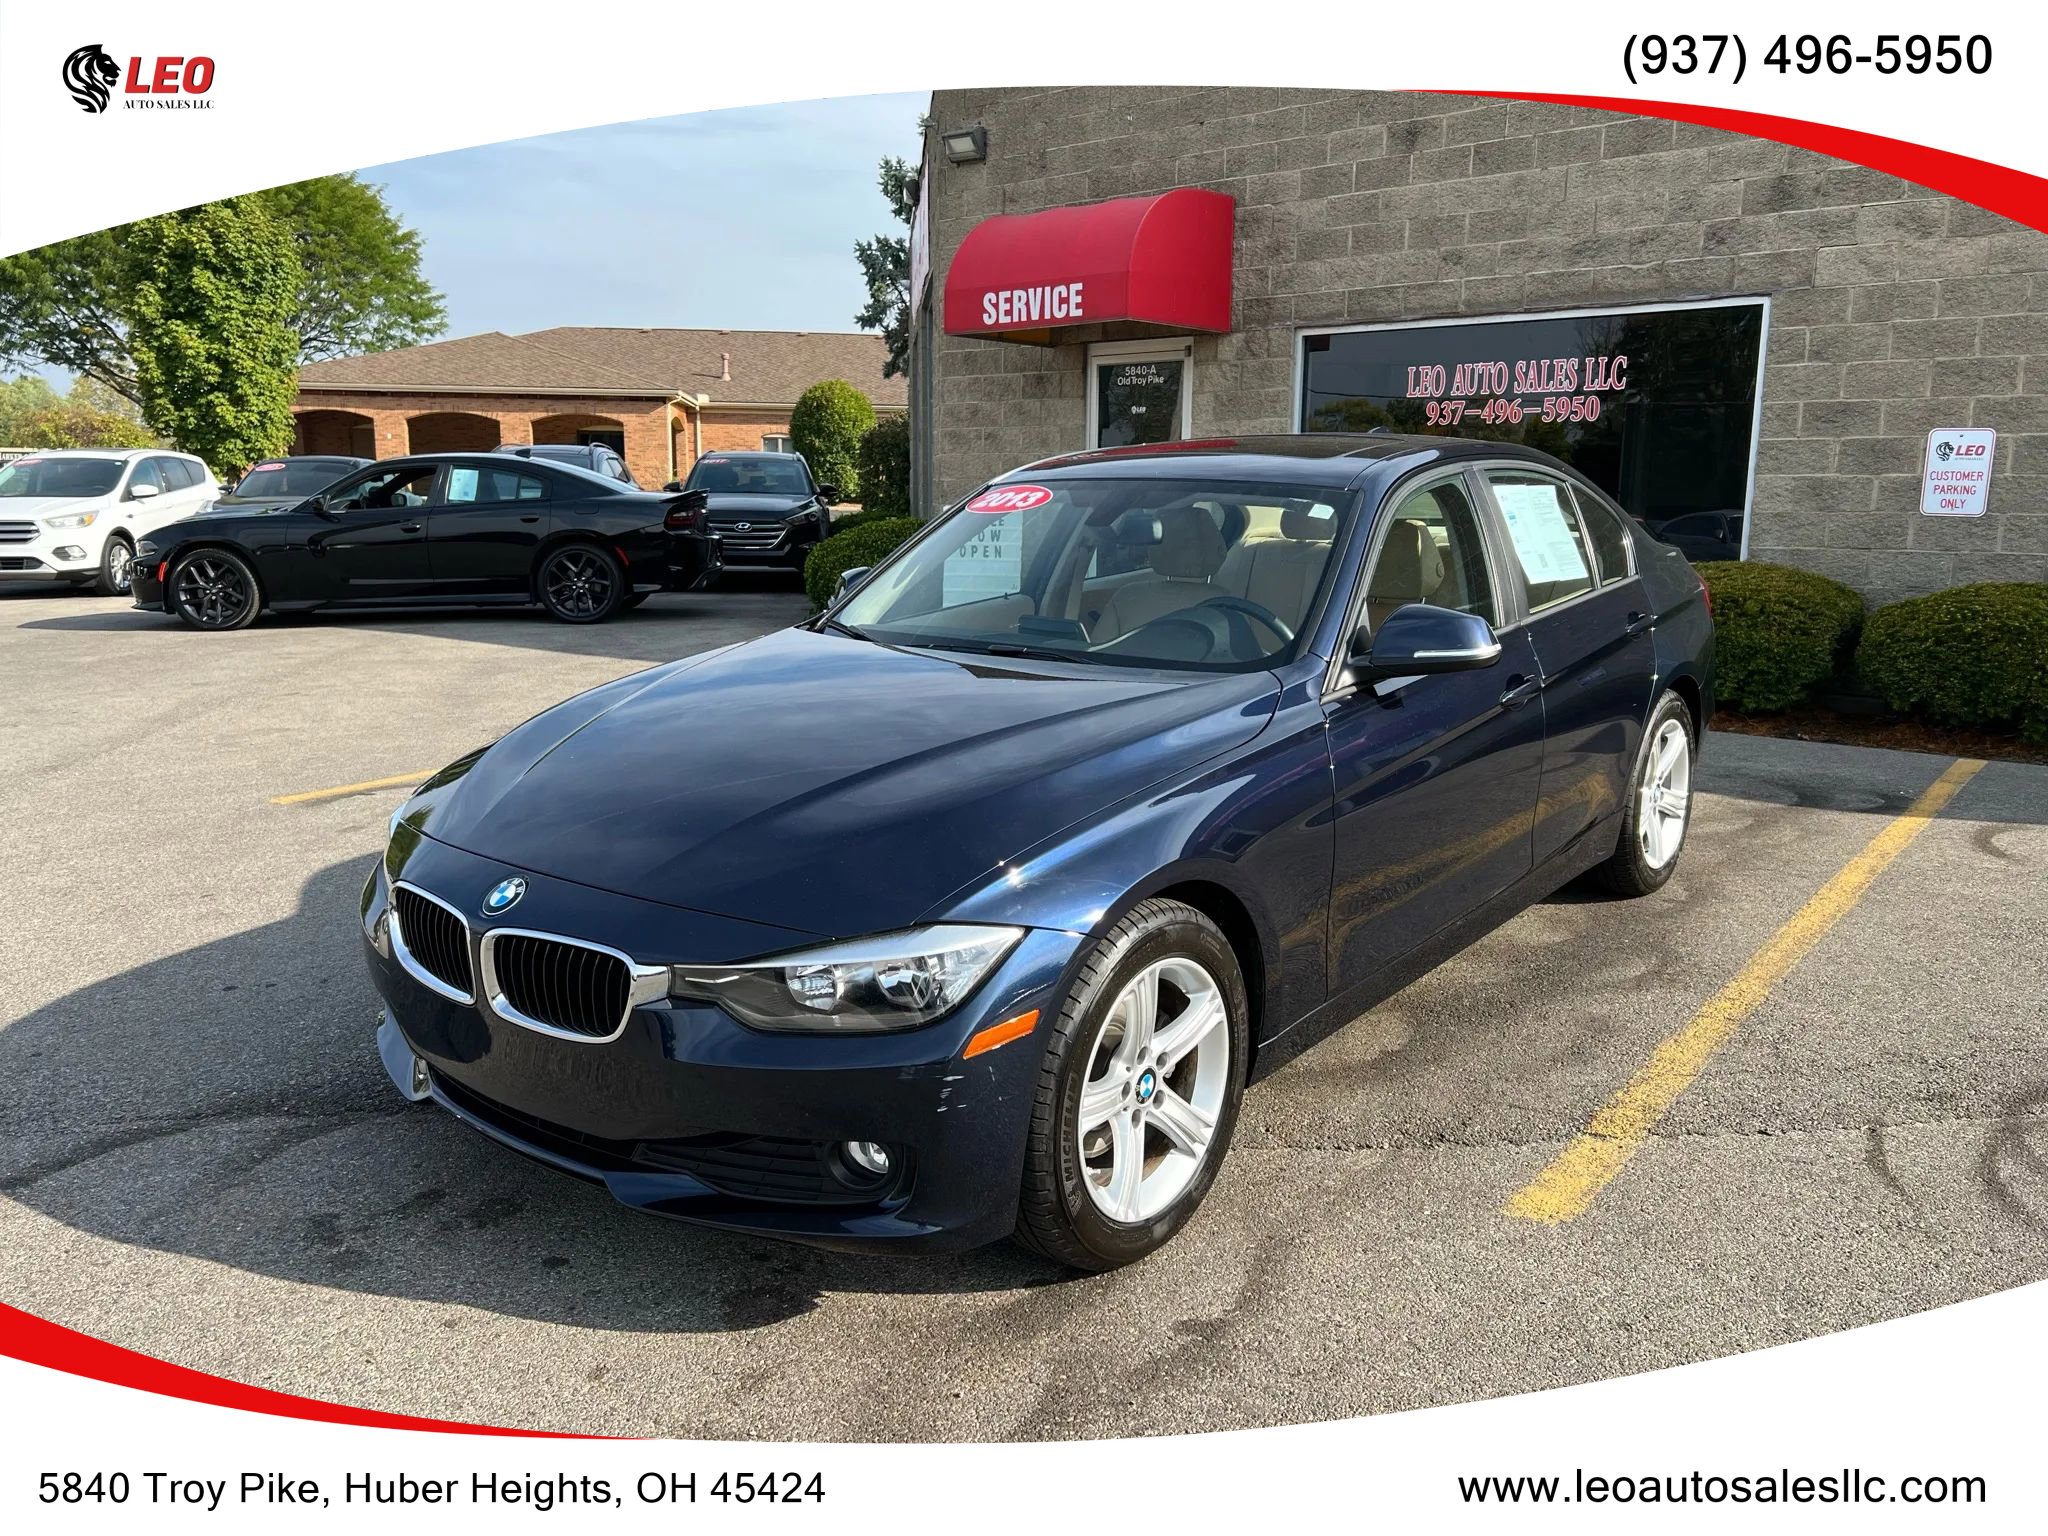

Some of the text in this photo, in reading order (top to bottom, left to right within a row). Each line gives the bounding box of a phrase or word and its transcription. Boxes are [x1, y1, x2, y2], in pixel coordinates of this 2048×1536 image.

[983, 282, 1083, 325] SERVICE
[1125, 365, 1156, 376] 5840-A
[1406, 355, 1628, 398] LEO AUTO SALES LLC
[1117, 375, 1164, 387] Old Troy Pike
[1425, 395, 1601, 426] 937-496-5950
[1955, 445, 1986, 456] LEO
[1930, 470, 1984, 482] CUSTOMER
[1933, 484, 1977, 496] PARKING
[971, 491, 1045, 509] 2013
[1940, 498, 1967, 509] ONLY
[960, 545, 1002, 558] OPEN
[1062, 1073, 1078, 1183] MICHELIN
